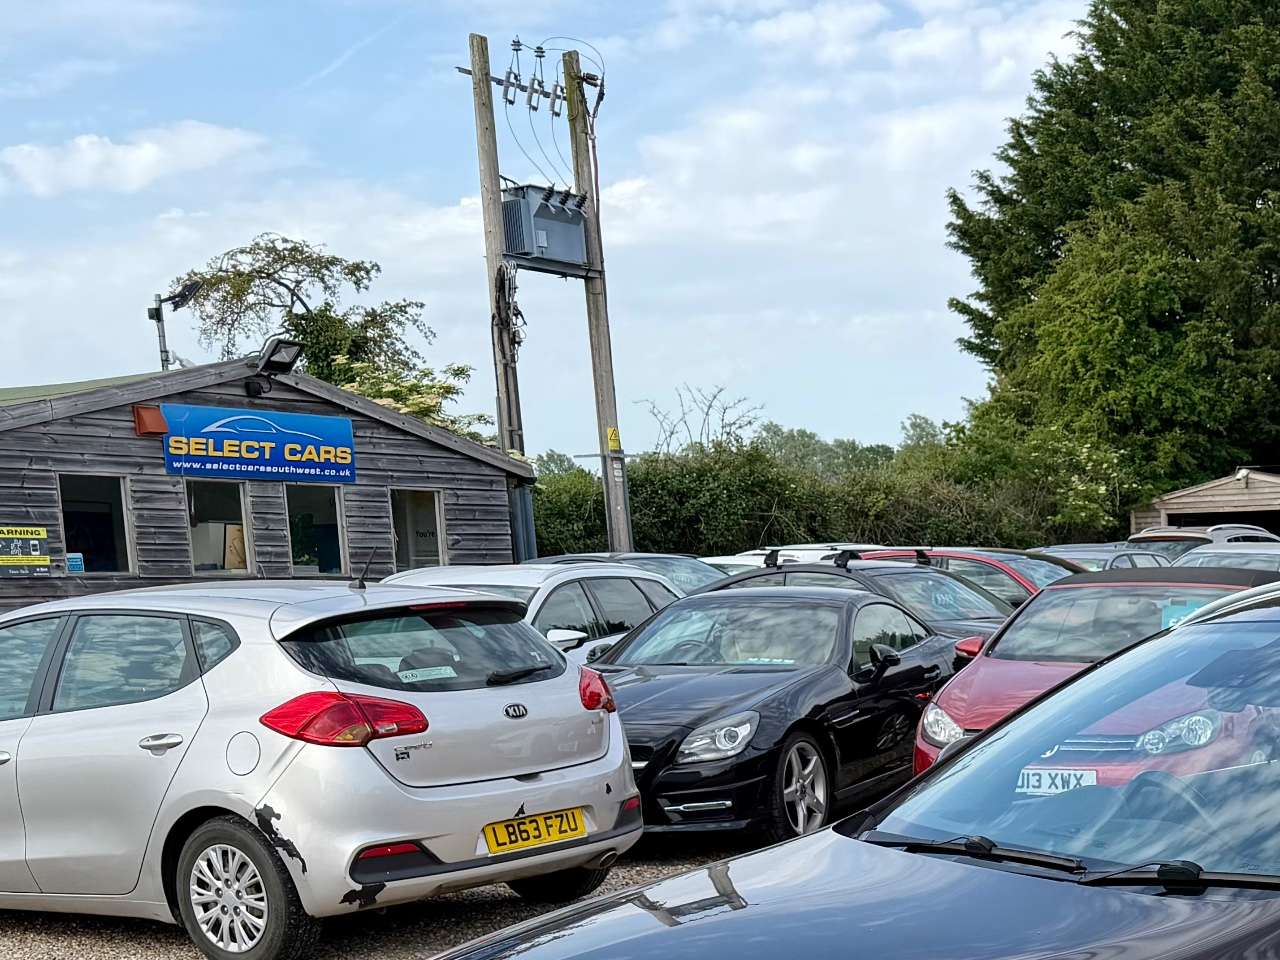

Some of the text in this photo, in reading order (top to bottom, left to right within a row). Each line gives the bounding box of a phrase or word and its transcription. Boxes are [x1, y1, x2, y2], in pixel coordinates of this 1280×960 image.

[168, 436, 352, 464] SELECT CARS
[172, 461, 351, 477] www.selectcarssouthwest.co.uk
[507, 705, 527, 717] KIA
[1047, 773, 1084, 790] XWX
[492, 811, 579, 847] LB63 FZU
